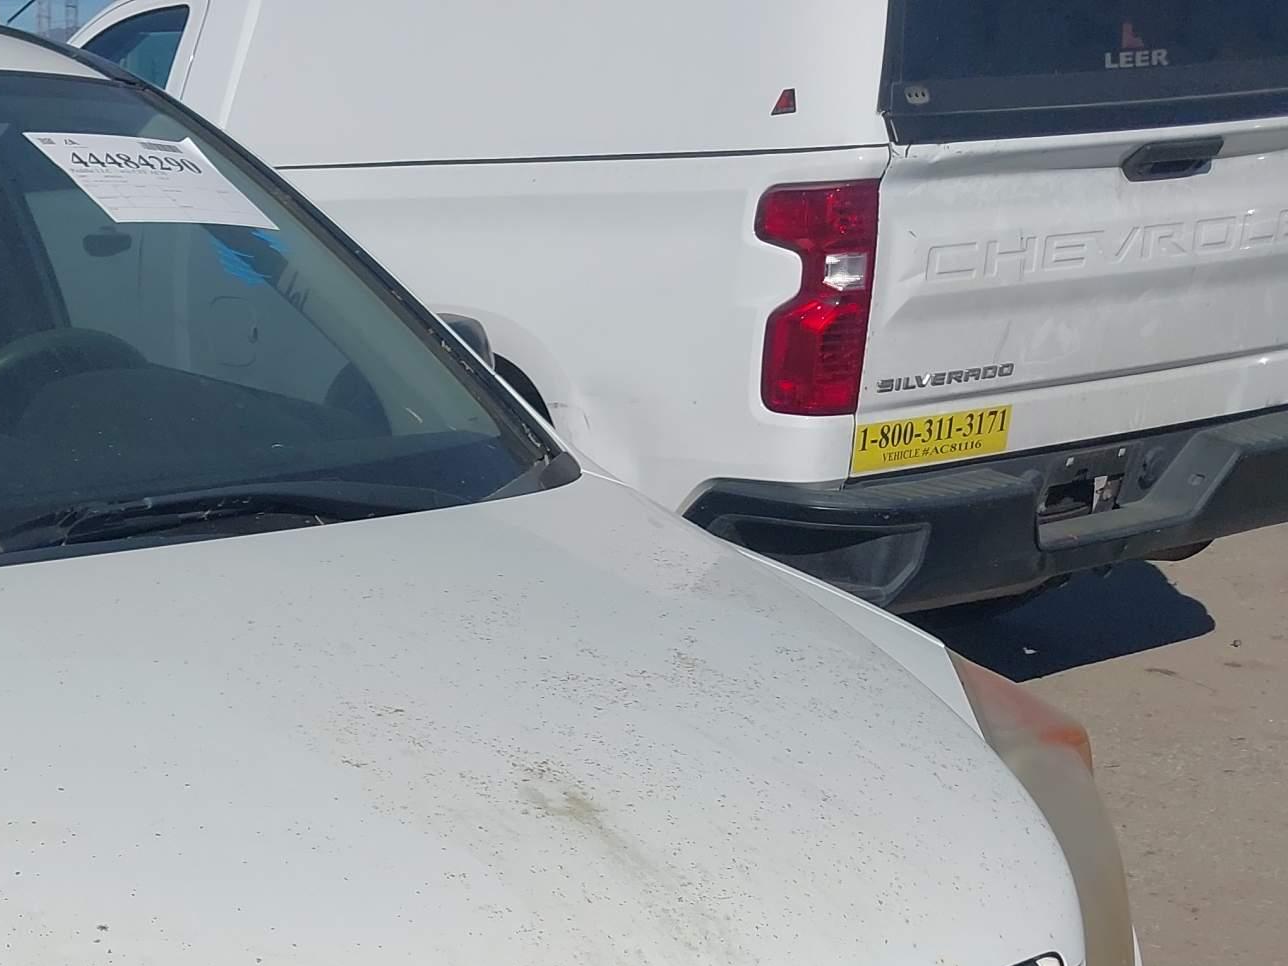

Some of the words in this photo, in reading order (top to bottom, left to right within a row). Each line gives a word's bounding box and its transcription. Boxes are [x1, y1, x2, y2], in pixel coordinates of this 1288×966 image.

[1104, 48, 1169, 69] LEER
[70, 151, 203, 175] 44484290
[876, 362, 1015, 393] SILVERADO
[858, 407, 1007, 452] 1-800-311-3171
[882, 448, 921, 463] VEHICLE
